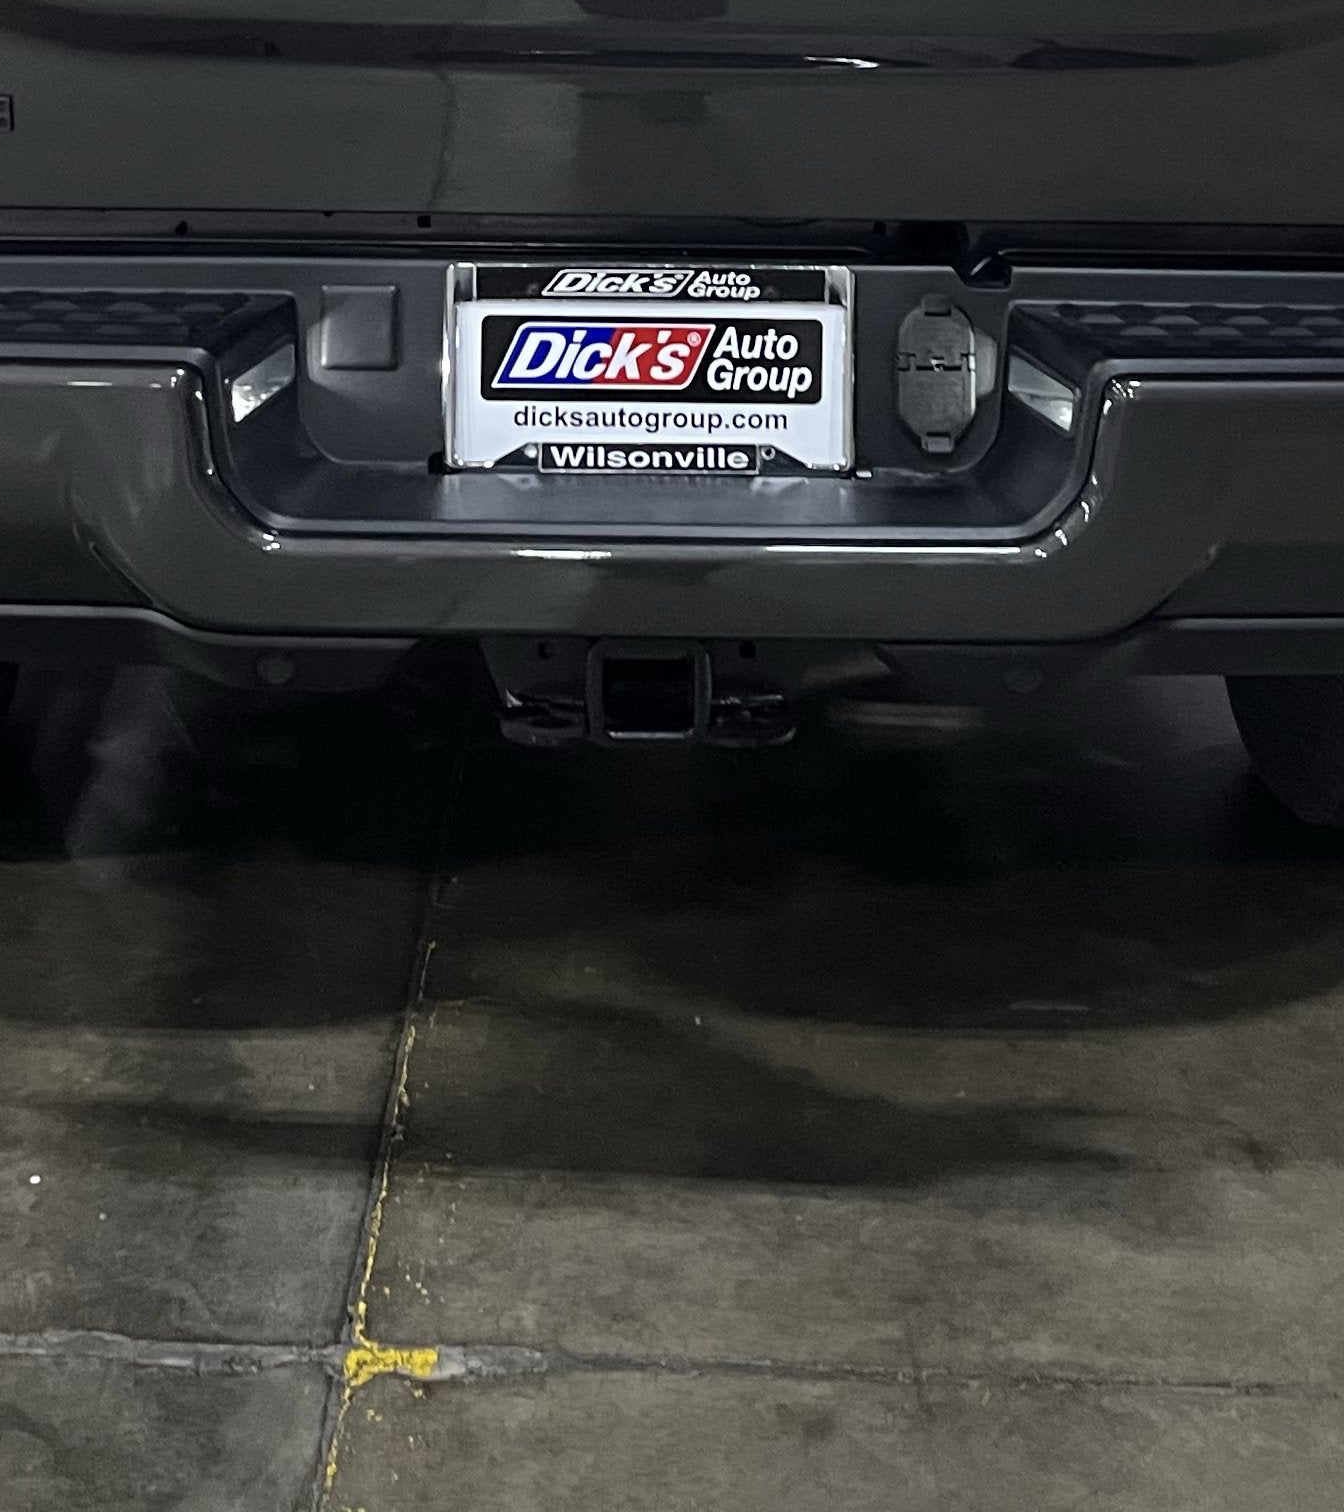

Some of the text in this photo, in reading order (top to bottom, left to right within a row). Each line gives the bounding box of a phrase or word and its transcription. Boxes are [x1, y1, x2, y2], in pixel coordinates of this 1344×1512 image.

[692, 271, 751, 286] Auto
[687, 284, 761, 300] Group
[713, 326, 798, 361] Auto
[707, 358, 812, 398] Group
[513, 406, 788, 433] dicksautogroup.com
[549, 445, 750, 469] Wilsonville
